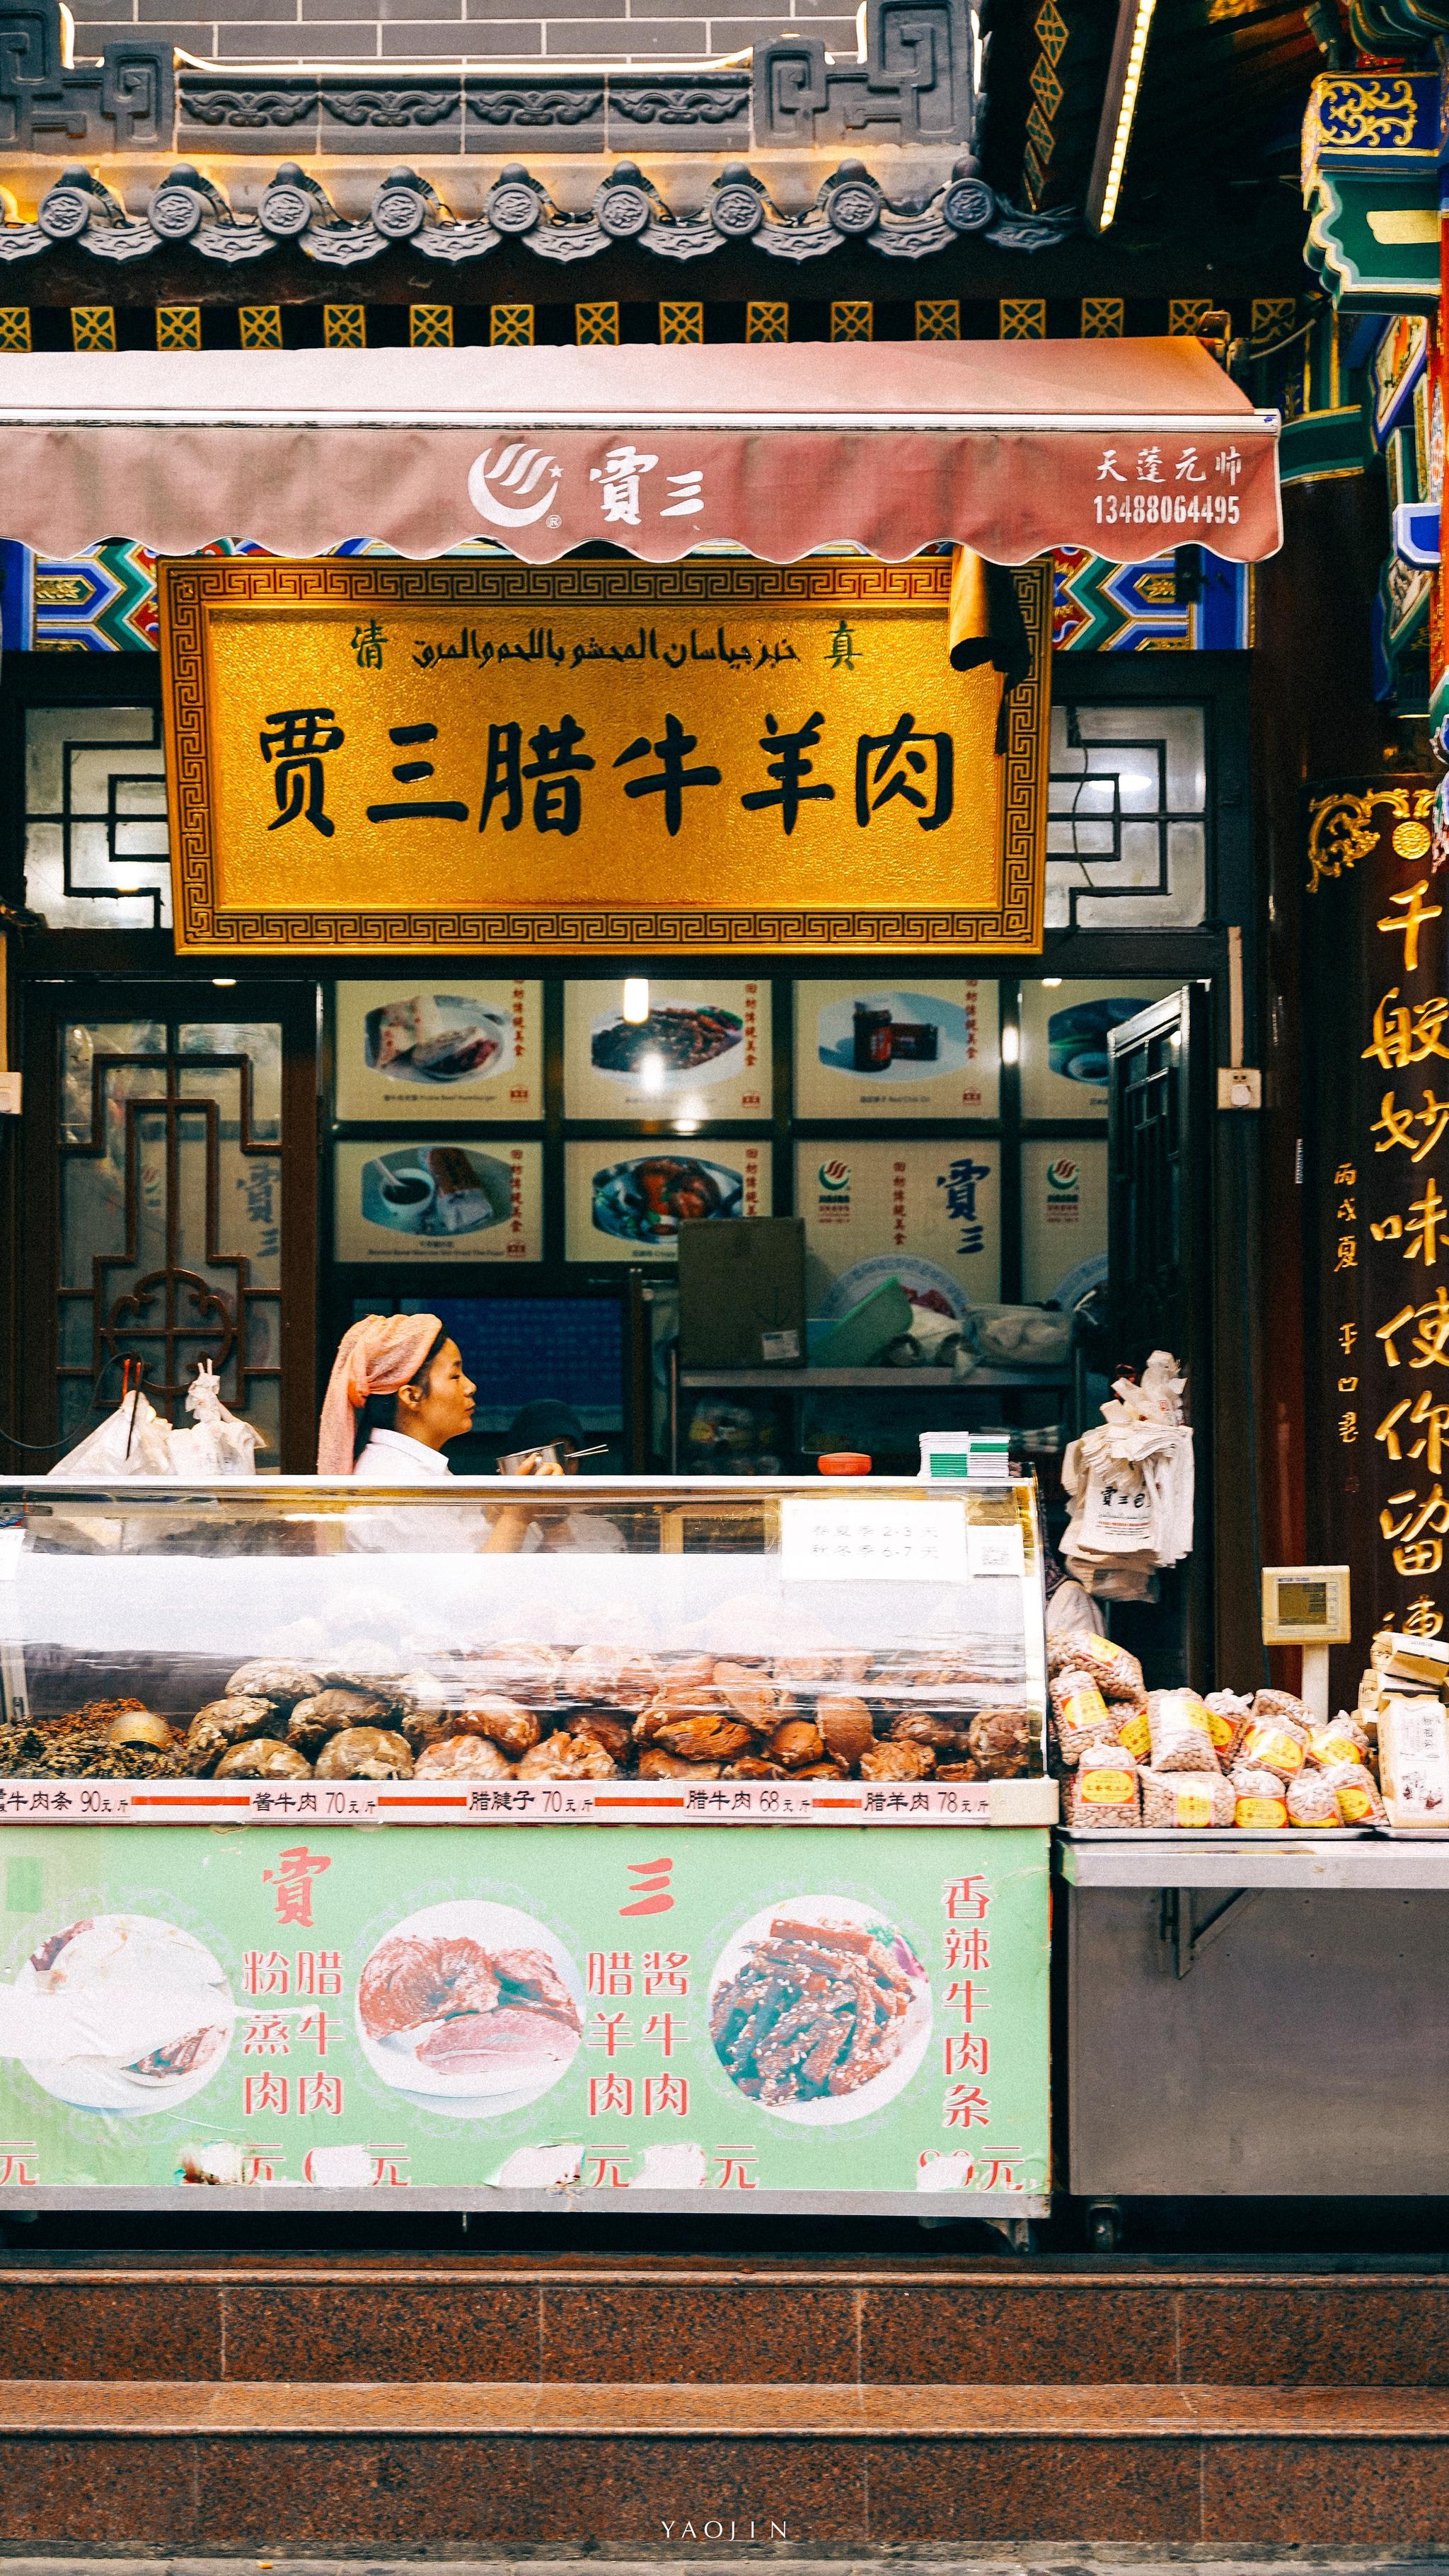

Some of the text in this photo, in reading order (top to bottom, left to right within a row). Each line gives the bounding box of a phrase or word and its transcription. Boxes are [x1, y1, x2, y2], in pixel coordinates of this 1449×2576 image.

[1096, 446, 1242, 486] 天蓬元帅
[1093, 495, 1240, 524] 13488064495
[351, 619, 388, 670] 清
[824, 620, 863, 671] 真
[259, 707, 955, 837] 贾三腊牛羊肉
[253, 1791, 318, 1813] 酱牛肉
[686, 1790, 751, 1811] 腊牛肉
[864, 1791, 930, 1812] 腊羊肉
[942, 1873, 991, 2129] 香辣牛肉条
[296, 1951, 345, 2116] 腊牛肉
[587, 1951, 635, 2117] 腊羊肉
[642, 1951, 691, 2117] 酱牛肉
